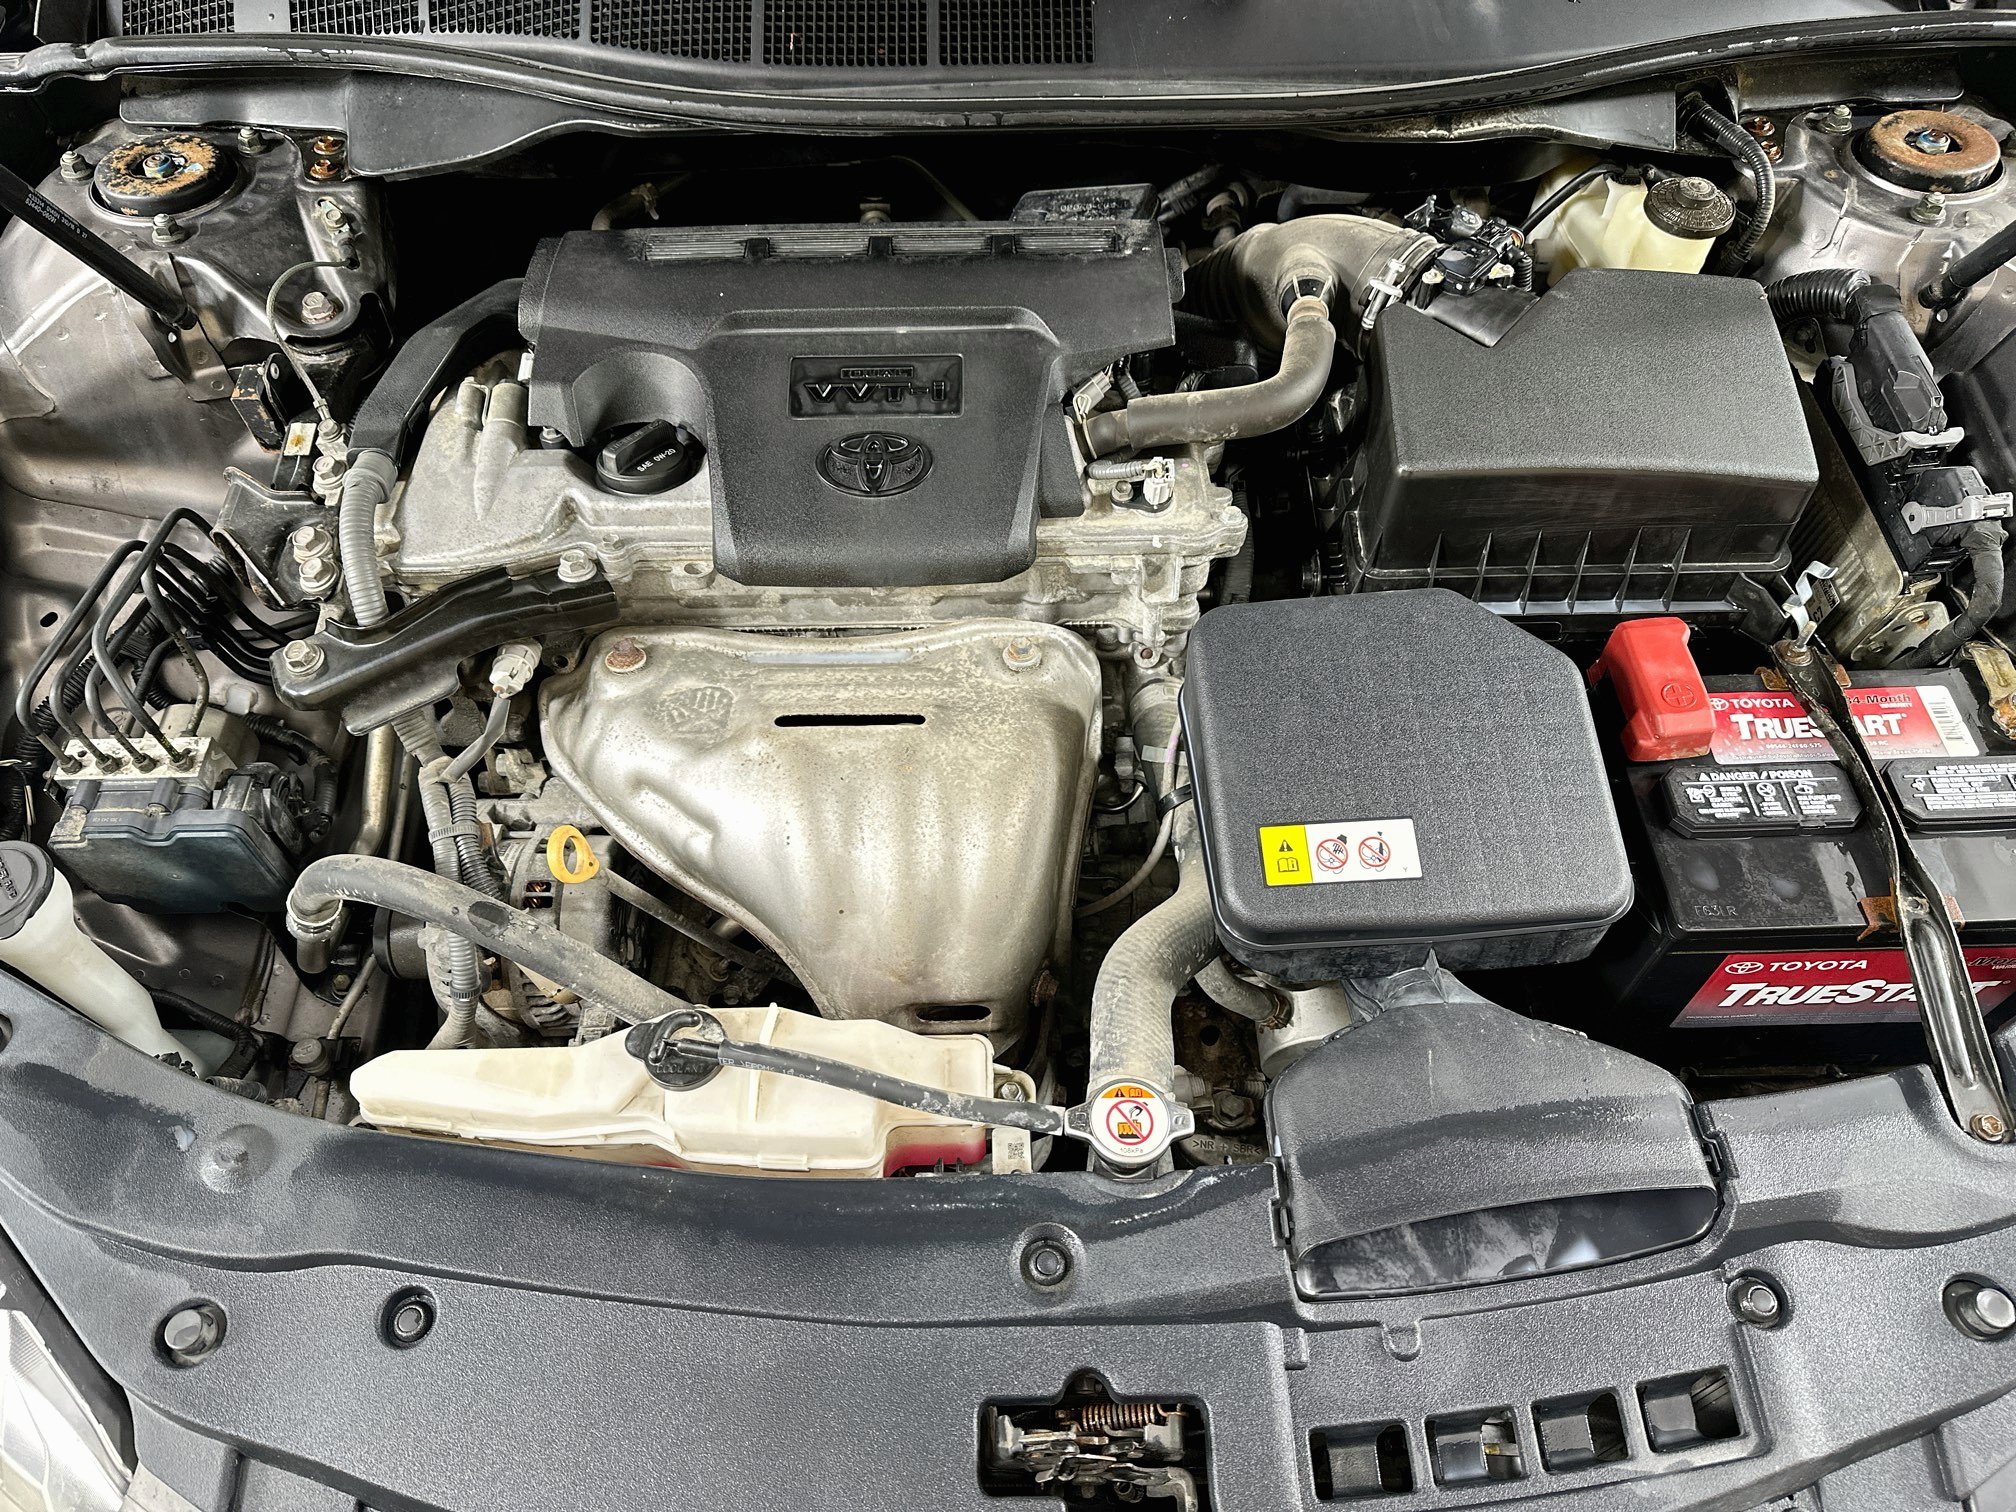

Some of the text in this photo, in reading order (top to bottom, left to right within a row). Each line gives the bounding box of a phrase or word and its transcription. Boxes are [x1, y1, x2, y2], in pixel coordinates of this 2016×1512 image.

[636, 447, 677, 472] SAE 0W-20
[1729, 698, 1795, 709] TOYOTA
[1848, 692, 1911, 704] 4-Month
[1710, 771, 1760, 781] DANGER
[1769, 769, 1813, 779] POISON
[1769, 959, 1868, 972] TOYOTA
[1192, 1139, 1215, 1150] >NR
